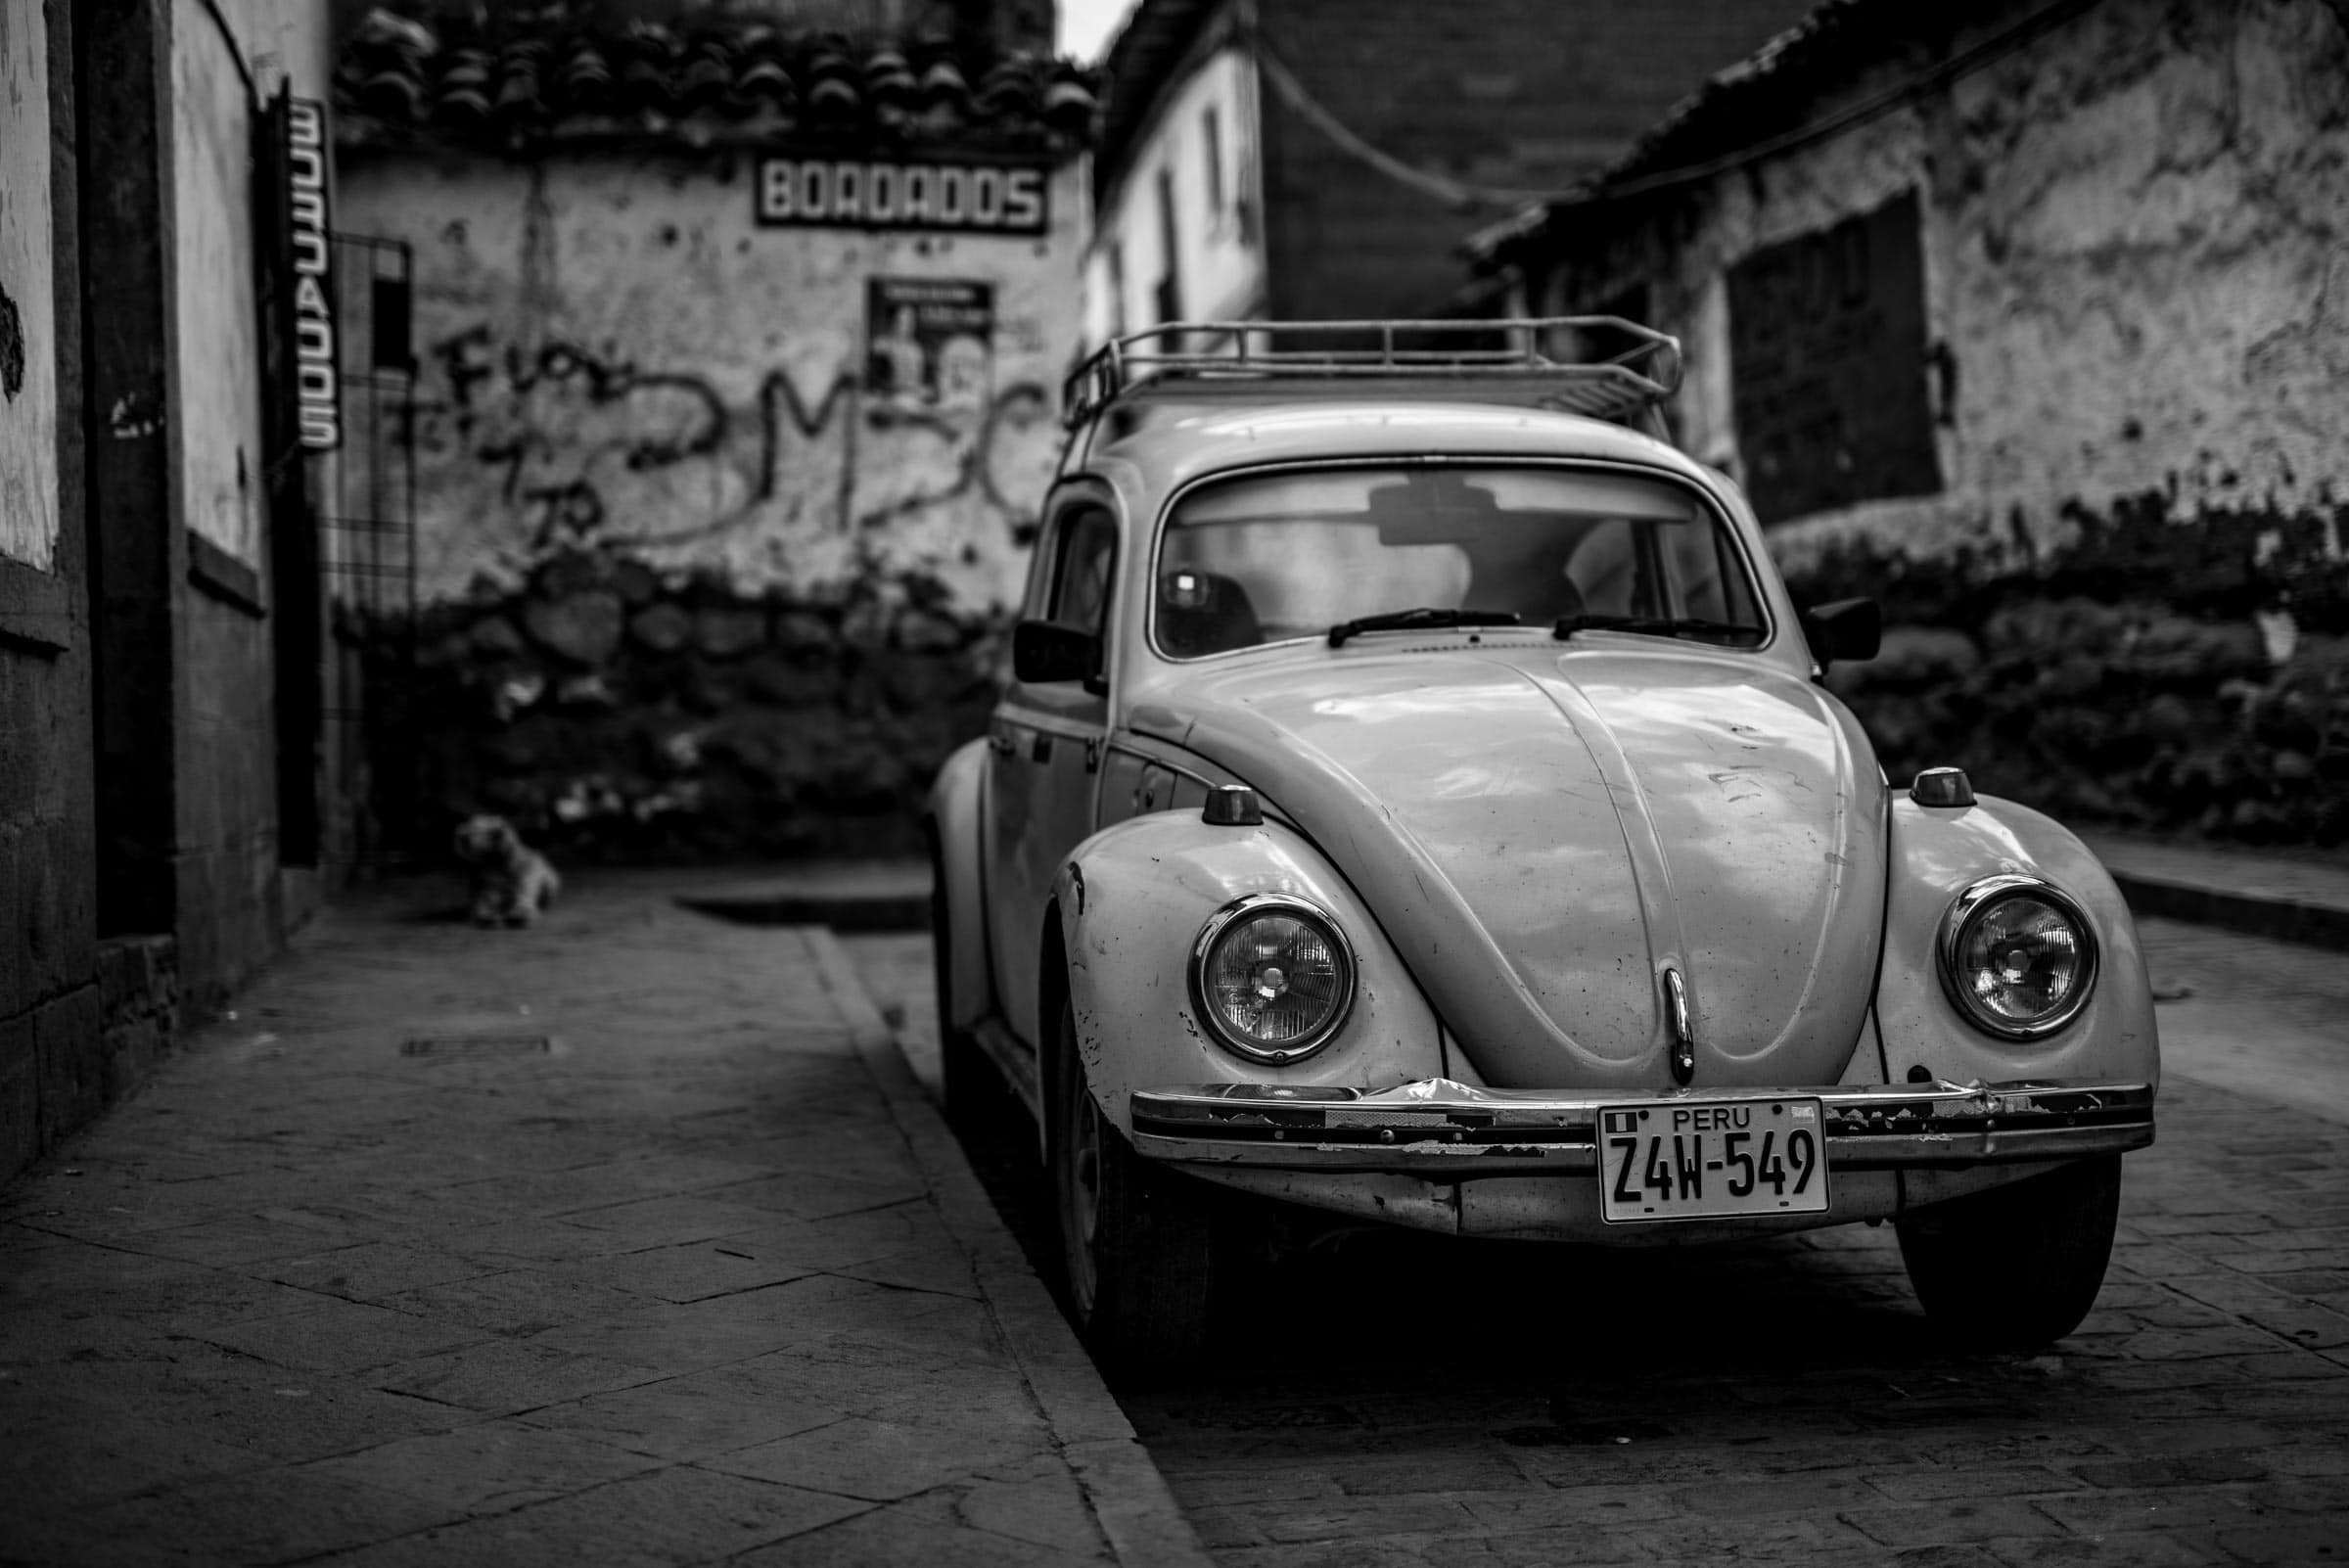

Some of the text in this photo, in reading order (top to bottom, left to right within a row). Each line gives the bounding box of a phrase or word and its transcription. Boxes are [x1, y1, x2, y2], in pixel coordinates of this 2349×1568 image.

[762, 159, 1043, 227] BORDADOS
[1673, 1107, 1751, 1131] PERU
[1610, 1129, 1816, 1203] Z4W-549
